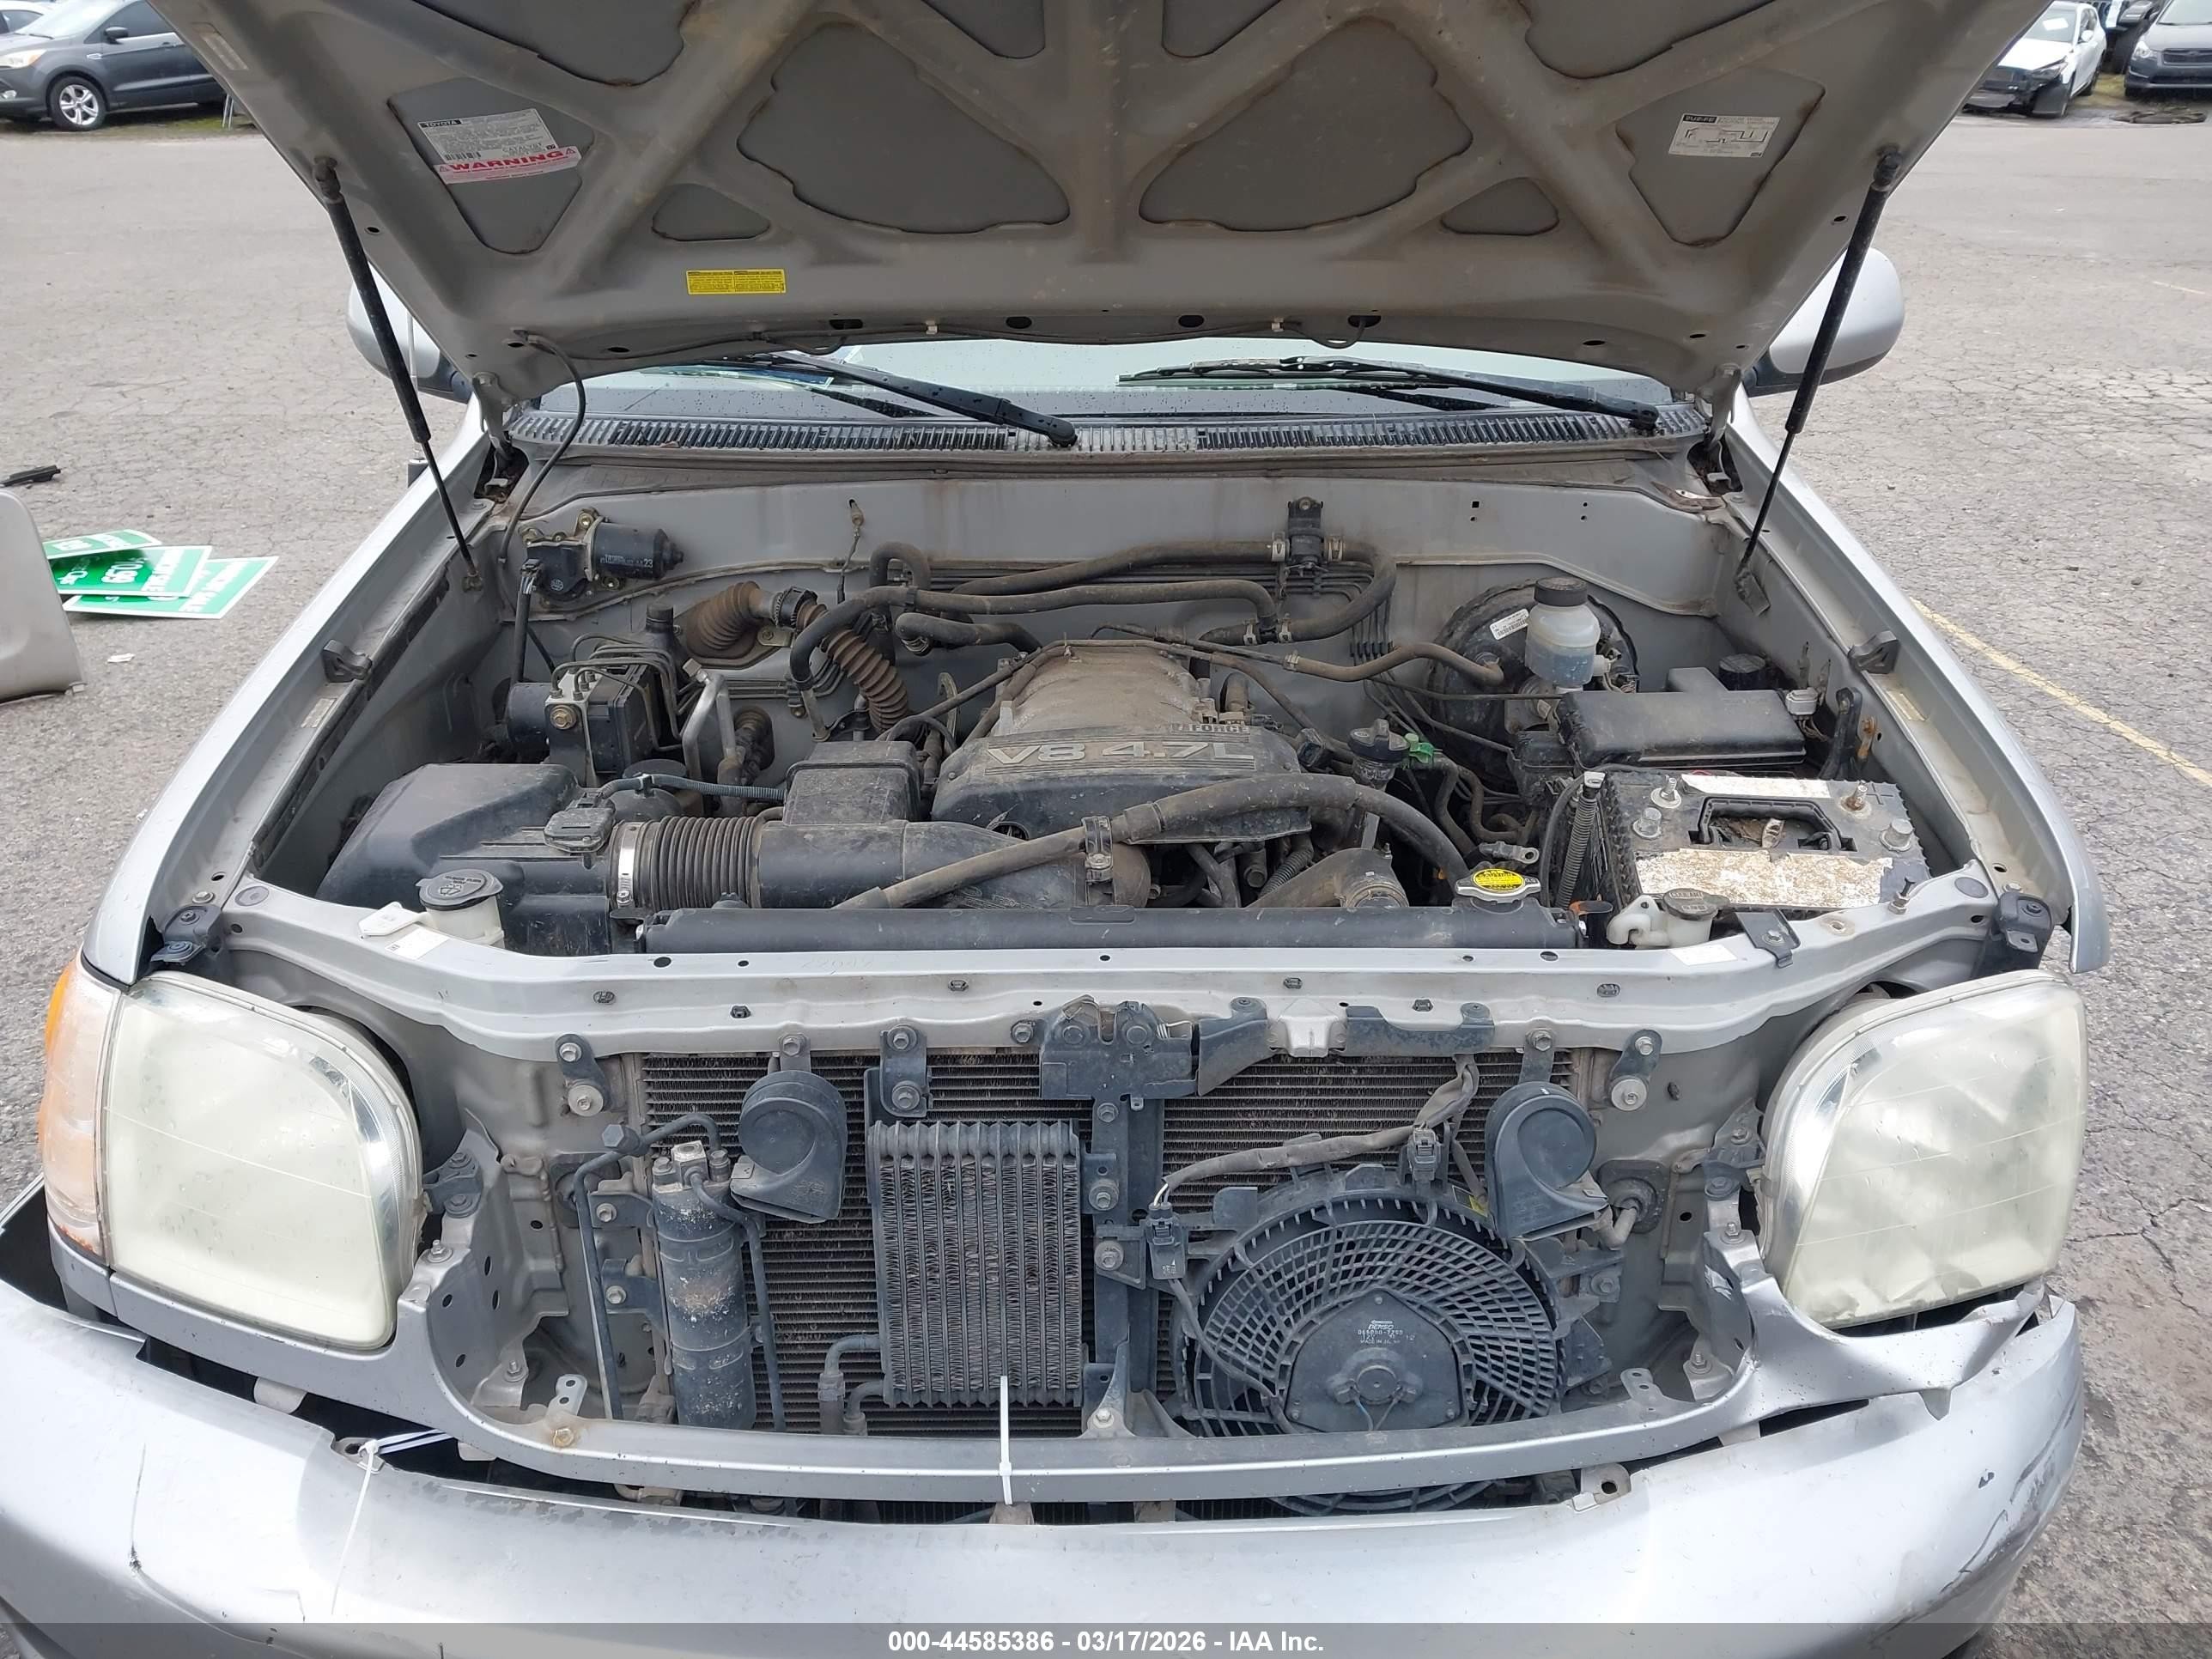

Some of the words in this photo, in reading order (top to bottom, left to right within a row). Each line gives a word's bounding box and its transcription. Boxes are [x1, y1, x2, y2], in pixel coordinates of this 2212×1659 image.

[448, 151, 563, 171] WARNING
[988, 742, 1086, 764] V8
[1103, 741, 1255, 759] 4.7L
